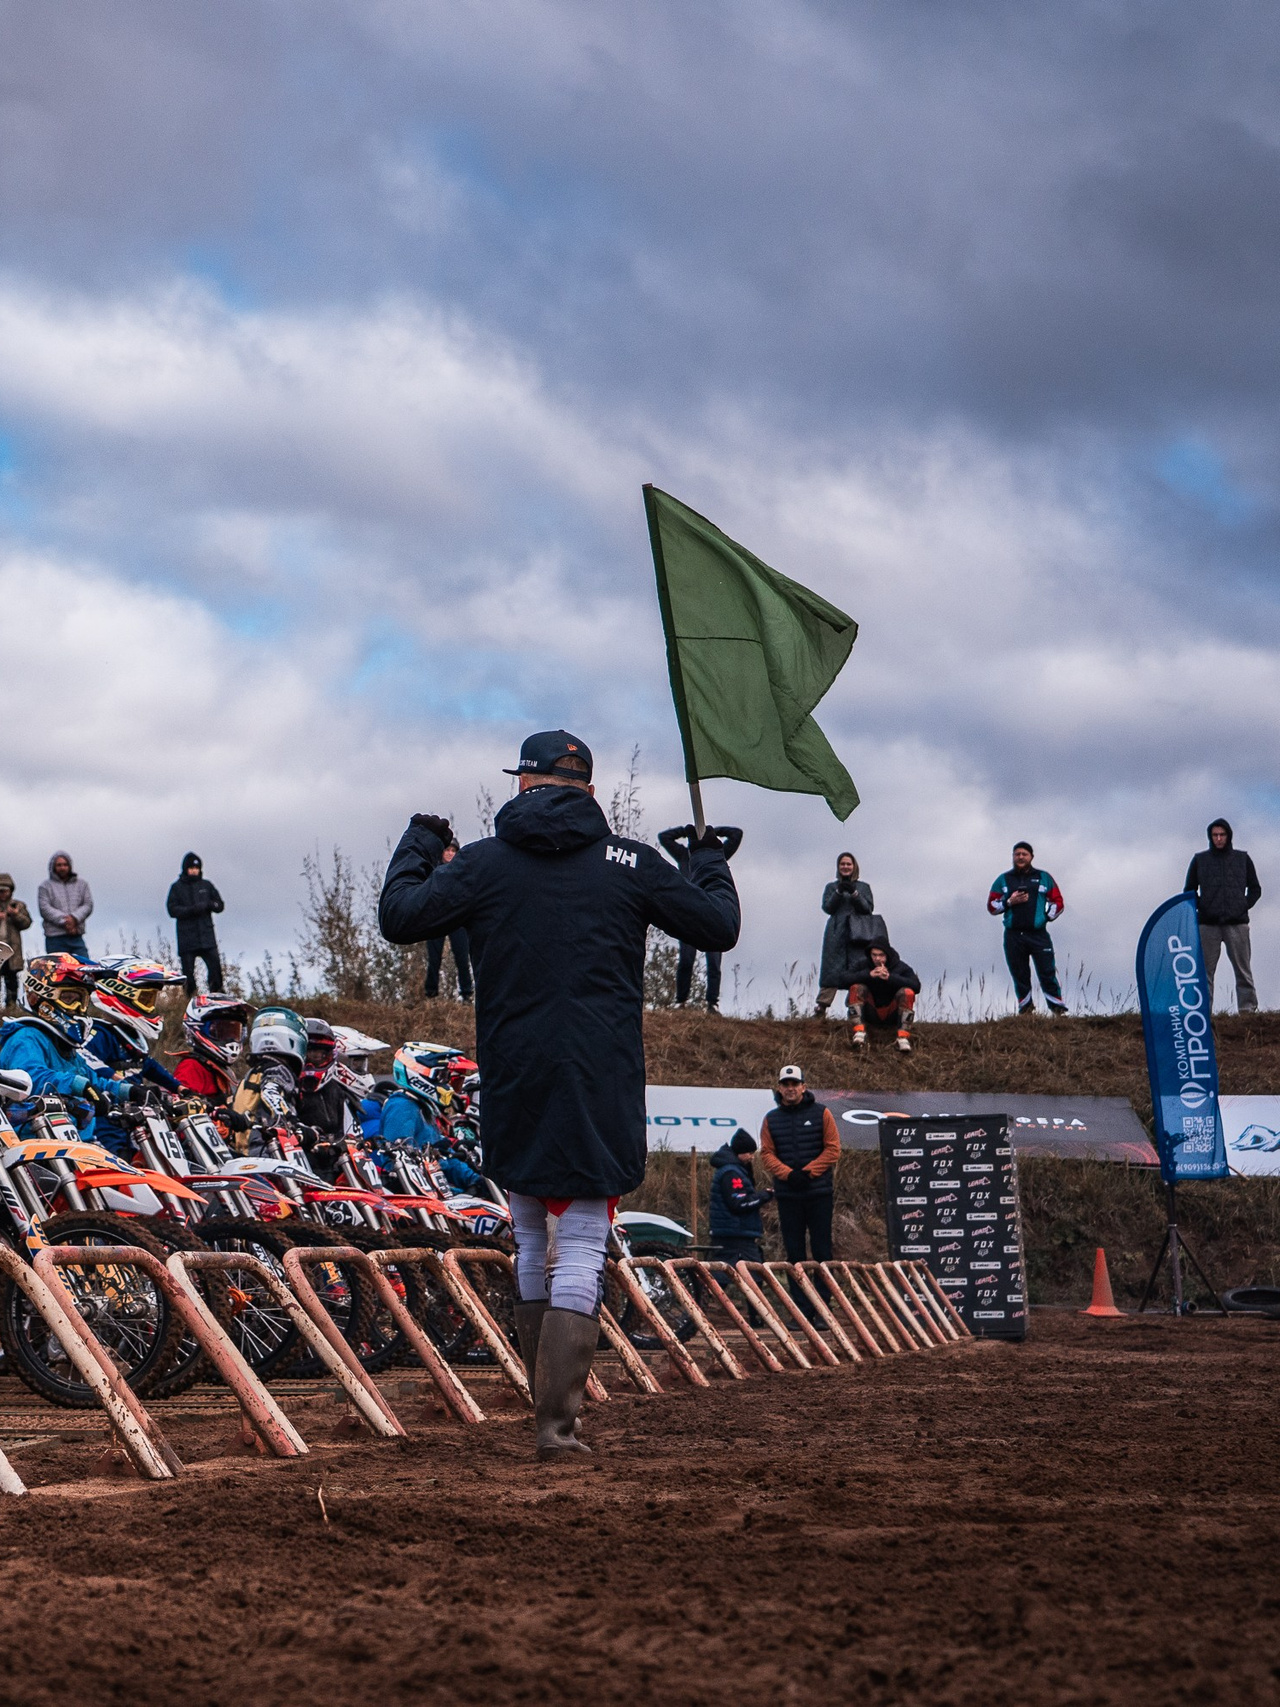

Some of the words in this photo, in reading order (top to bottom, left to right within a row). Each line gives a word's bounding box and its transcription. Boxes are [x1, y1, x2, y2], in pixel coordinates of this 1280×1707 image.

[24, 975, 57, 998] 100%
[1167, 935, 1212, 1079] ПРОСТОР
[1168, 1005, 1190, 1079] КОМПАНИЯ
[647, 1115, 738, 1128] OTO
[896, 1128, 917, 1136] FOX
[966, 1143, 987, 1151] FOX
[933, 1159, 954, 1167] FOX
[900, 1176, 921, 1184] FOX
[970, 1192, 991, 1200] FOX
[937, 1208, 958, 1216] FOX
[904, 1224, 925, 1232] FOX
[974, 1240, 995, 1248] FOX
[940, 1257, 961, 1265] FOX
[977, 1289, 998, 1297] FOX
